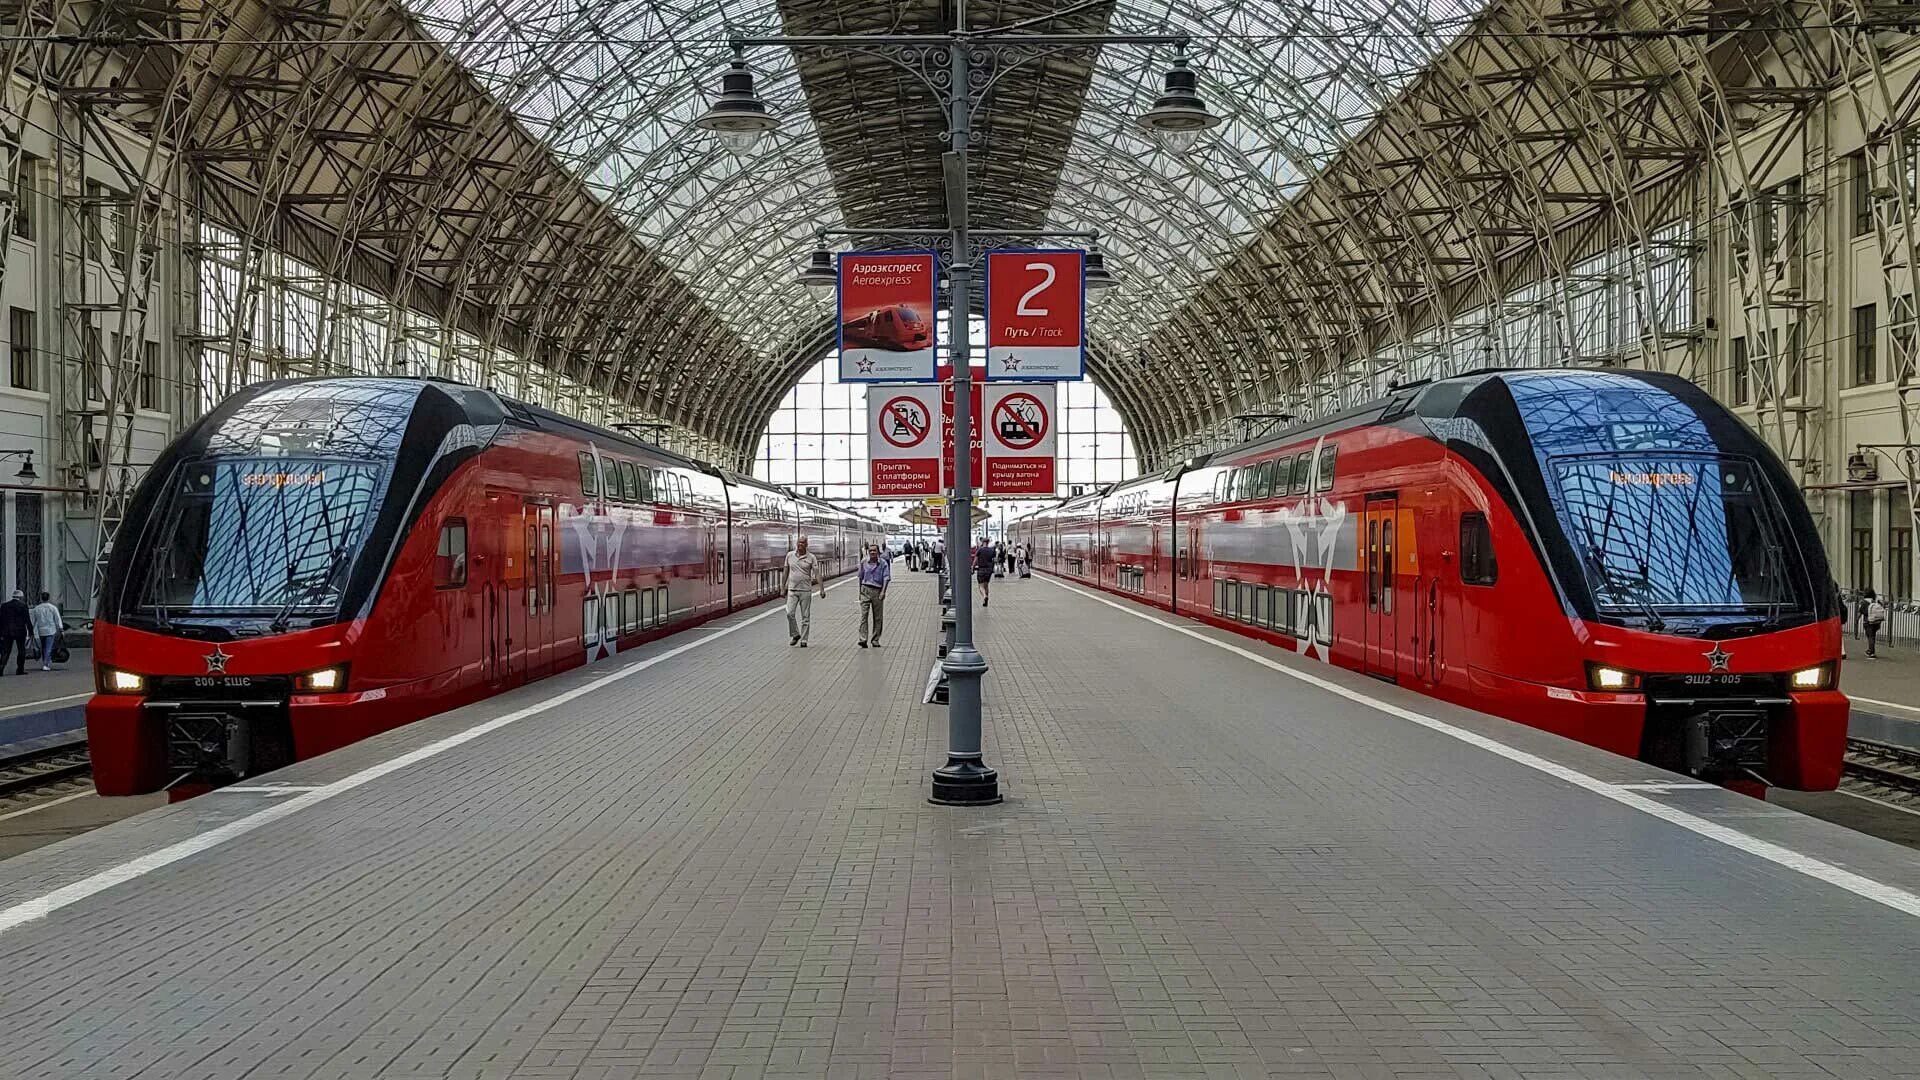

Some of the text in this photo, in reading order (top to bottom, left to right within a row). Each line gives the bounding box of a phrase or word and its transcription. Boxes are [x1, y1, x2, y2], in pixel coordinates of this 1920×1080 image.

[852, 263, 923, 275] Аэроэкспресс
[852, 275, 912, 287] Aeroexpress
[1016, 262, 1056, 316] 2
[1004, 327, 1029, 339] Путь
[1040, 327, 1063, 337] Track
[876, 462, 911, 472] Прыгать
[992, 462, 1037, 470] Подниматься
[883, 472, 931, 481] платформы
[992, 472, 1015, 480] крышу
[877, 481, 926, 491] запрещено!
[992, 480, 1033, 488] запрещено!
[1684, 674, 1712, 685] ЭШ2
[1721, 674, 1742, 684] 005
